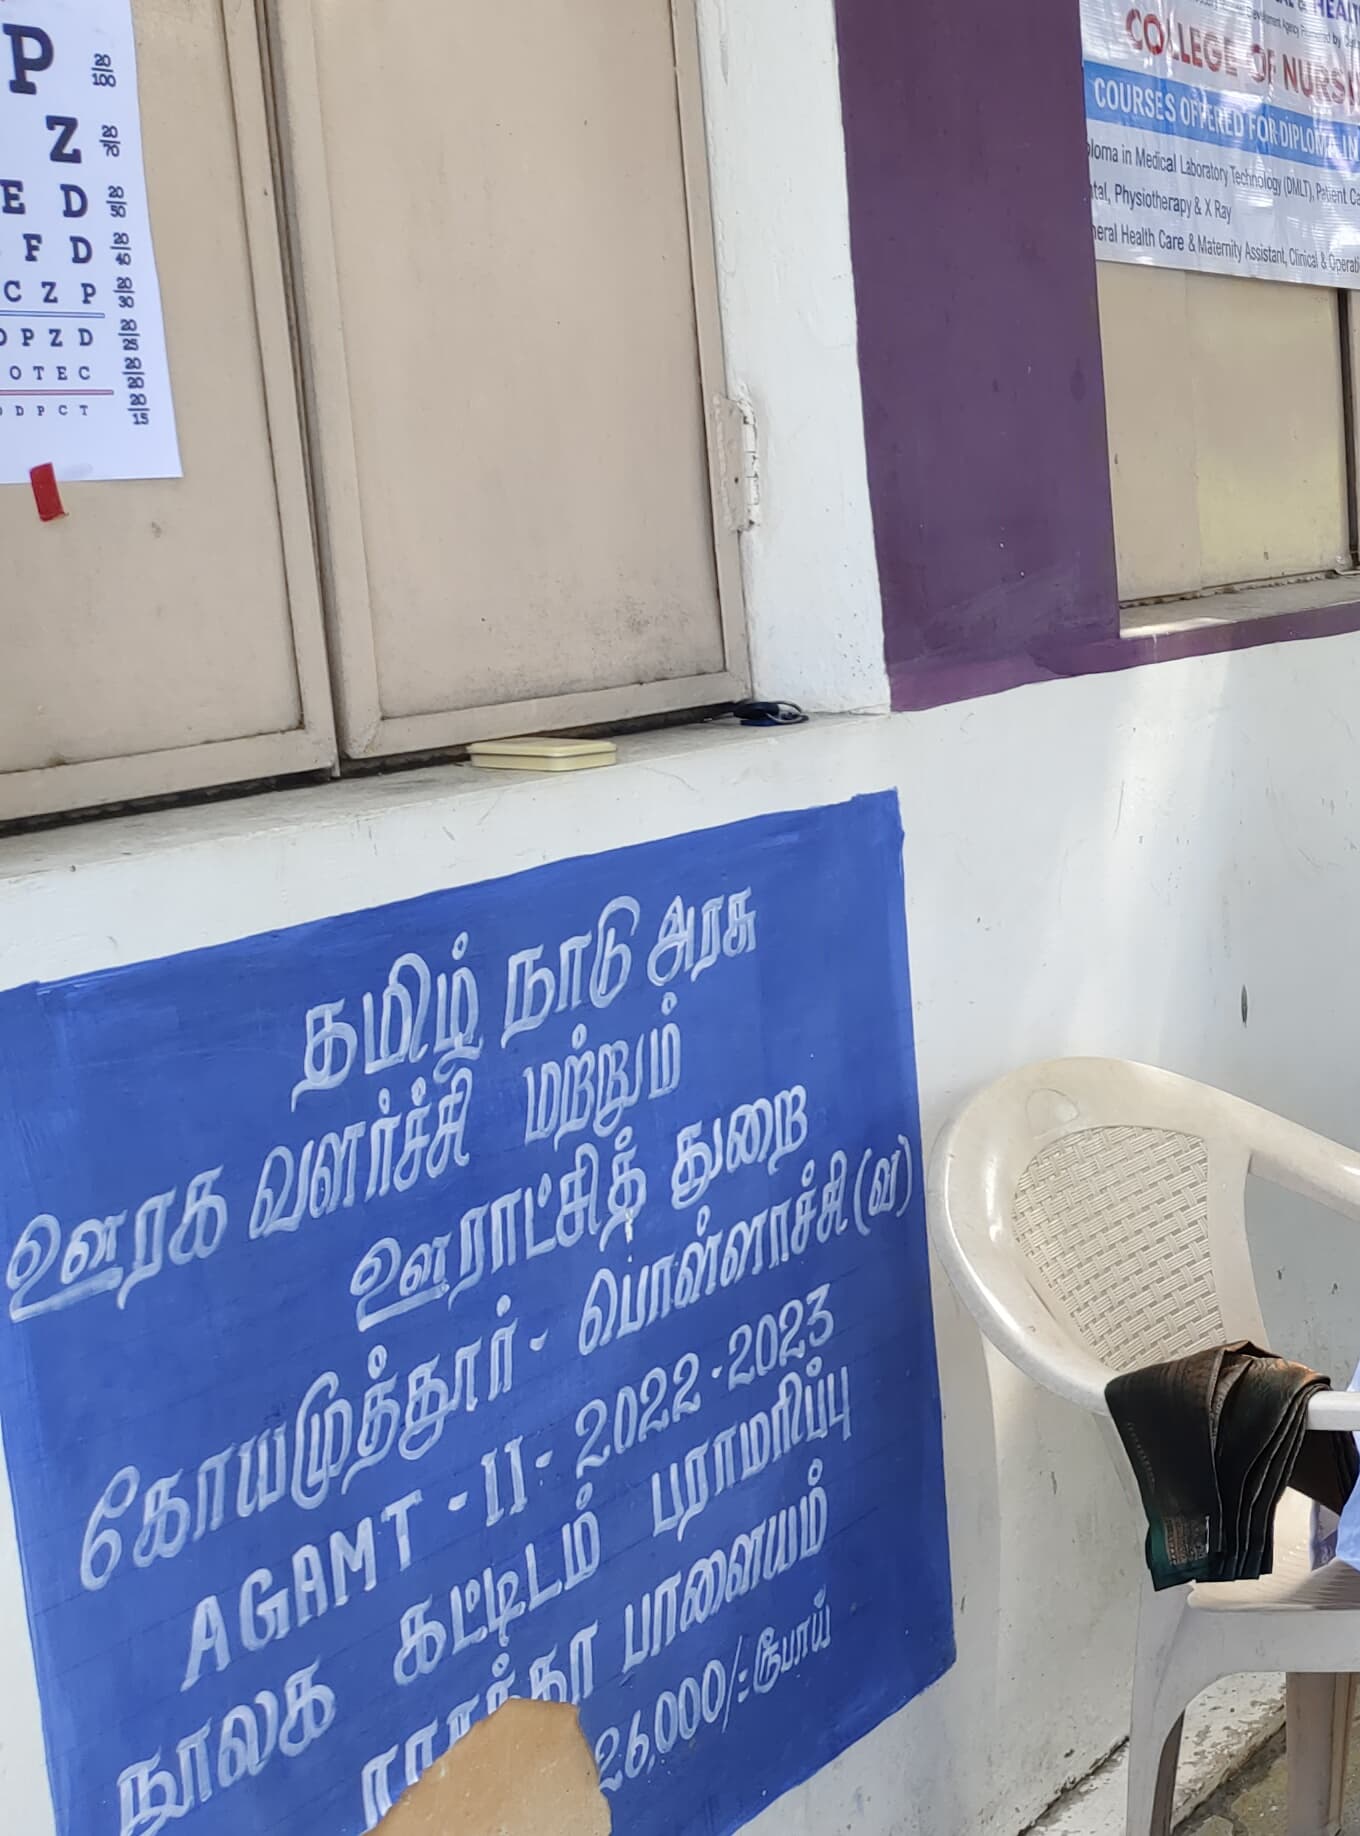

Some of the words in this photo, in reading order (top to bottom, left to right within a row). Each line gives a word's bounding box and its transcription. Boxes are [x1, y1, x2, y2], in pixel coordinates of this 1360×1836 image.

[2, 23, 54, 95] P
[1126, 8, 1237, 77] COLLEGE
[46, 115, 82, 164] Z
[1094, 77, 1176, 122] COURSES
[1180, 97, 1244, 139] OFFERED
[1248, 114, 1279, 146] FOR
[1280, 120, 1340, 159] DIPLOMA
[1342, 134, 1360, 161] IN
[0, 179, 26, 215] E
[60, 184, 88, 218] D
[1115, 184, 1192, 218] Physiotherapy
[1194, 196, 1202, 215] &
[1204, 199, 1212, 216] X
[1215, 200, 1232, 224] Ray
[1122, 144, 1132, 165] in
[1136, 147, 1176, 173] Medical
[1180, 155, 1228, 187] Laboratory
[1230, 164, 1282, 197] Technology
[1316, 182, 1346, 205] Patient
[22, 233, 42, 262] F
[69, 235, 93, 264] D
[1121, 224, 1156, 248] Health
[1158, 229, 1184, 250] Care
[1188, 234, 1196, 252] &
[1198, 236, 1243, 263] Maternity
[3, 280, 22, 302] C
[41, 281, 58, 304] Z
[81, 283, 96, 304] P
[20, 328, 35, 347] P
[49, 329, 63, 347] Z
[78, 328, 93, 347] D
[9, 365, 22, 380] O
[33, 366, 45, 380] T
[56, 366, 68, 380] E
[78, 366, 91, 380] C
[16, 405, 24, 416] D
[37, 406, 45, 416] P
[59, 405, 68, 416] C
[80, 405, 88, 416] T
[290, 931, 484, 1113] தமிழ்
[500, 895, 641, 1048] நாடு
[647, 886, 757, 987] அரசு
[6, 1164, 228, 1323] ஊரக
[249, 1066, 474, 1241] வளர்ச்சி
[522, 991, 682, 1152] மற்றும்
[349, 1126, 647, 1333] ஊராட்சித்
[116, 1656, 336, 1836] நூலக
[394, 1481, 600, 1686] கட்டிடம்
[650, 1356, 852, 1541] பராமரிப்பு
[180, 1489, 424, 1692] AGAMT
[622, 1458, 828, 1674] பாளையம்
